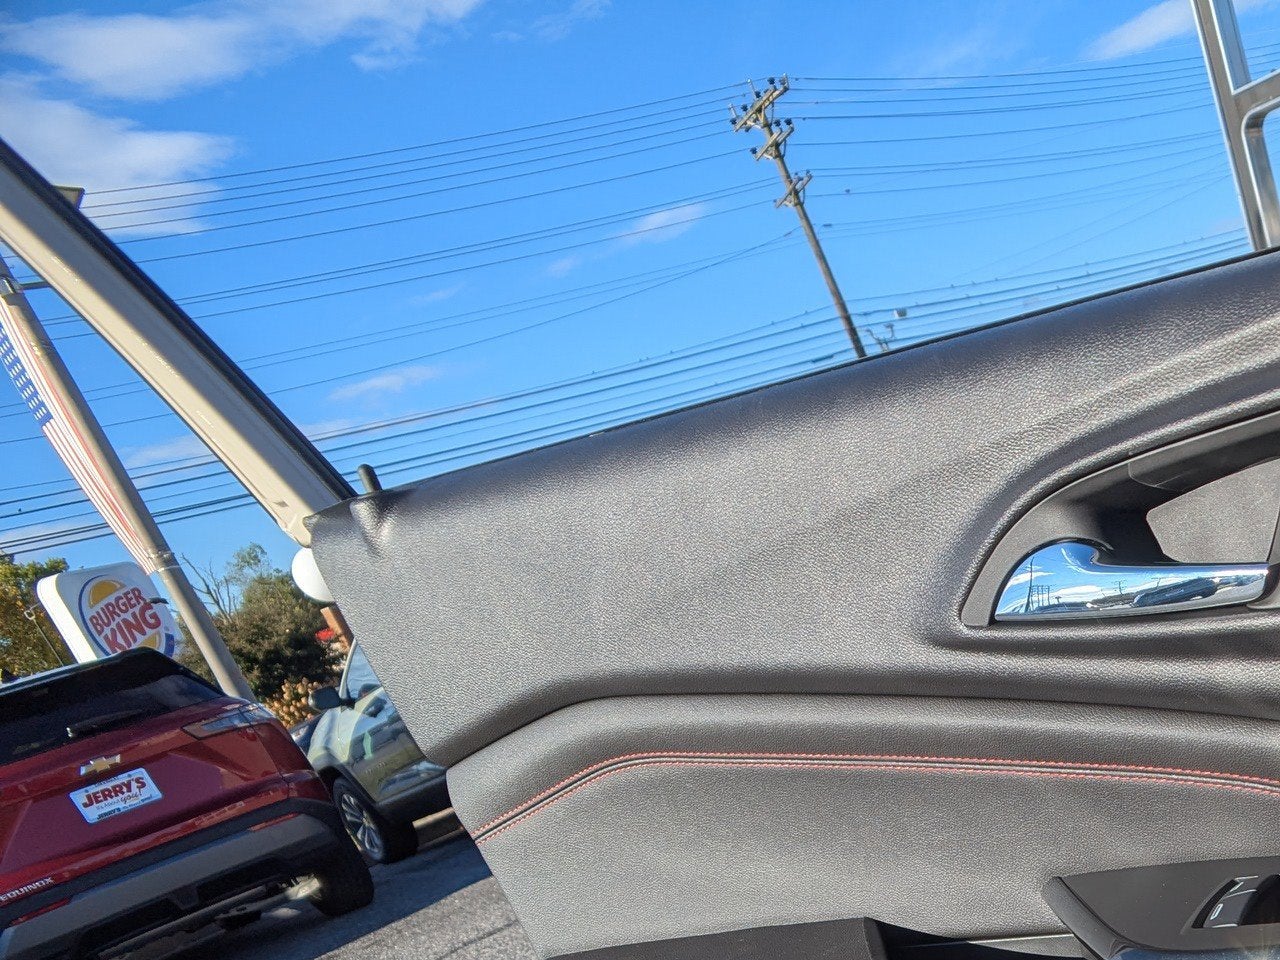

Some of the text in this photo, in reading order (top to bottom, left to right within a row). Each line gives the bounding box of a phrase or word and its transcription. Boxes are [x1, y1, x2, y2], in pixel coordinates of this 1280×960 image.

[88, 587, 147, 636] BURGER
[103, 602, 162, 654] KING
[82, 776, 147, 809] JERRY'S
[0, 876, 54, 901] EQUINOX
